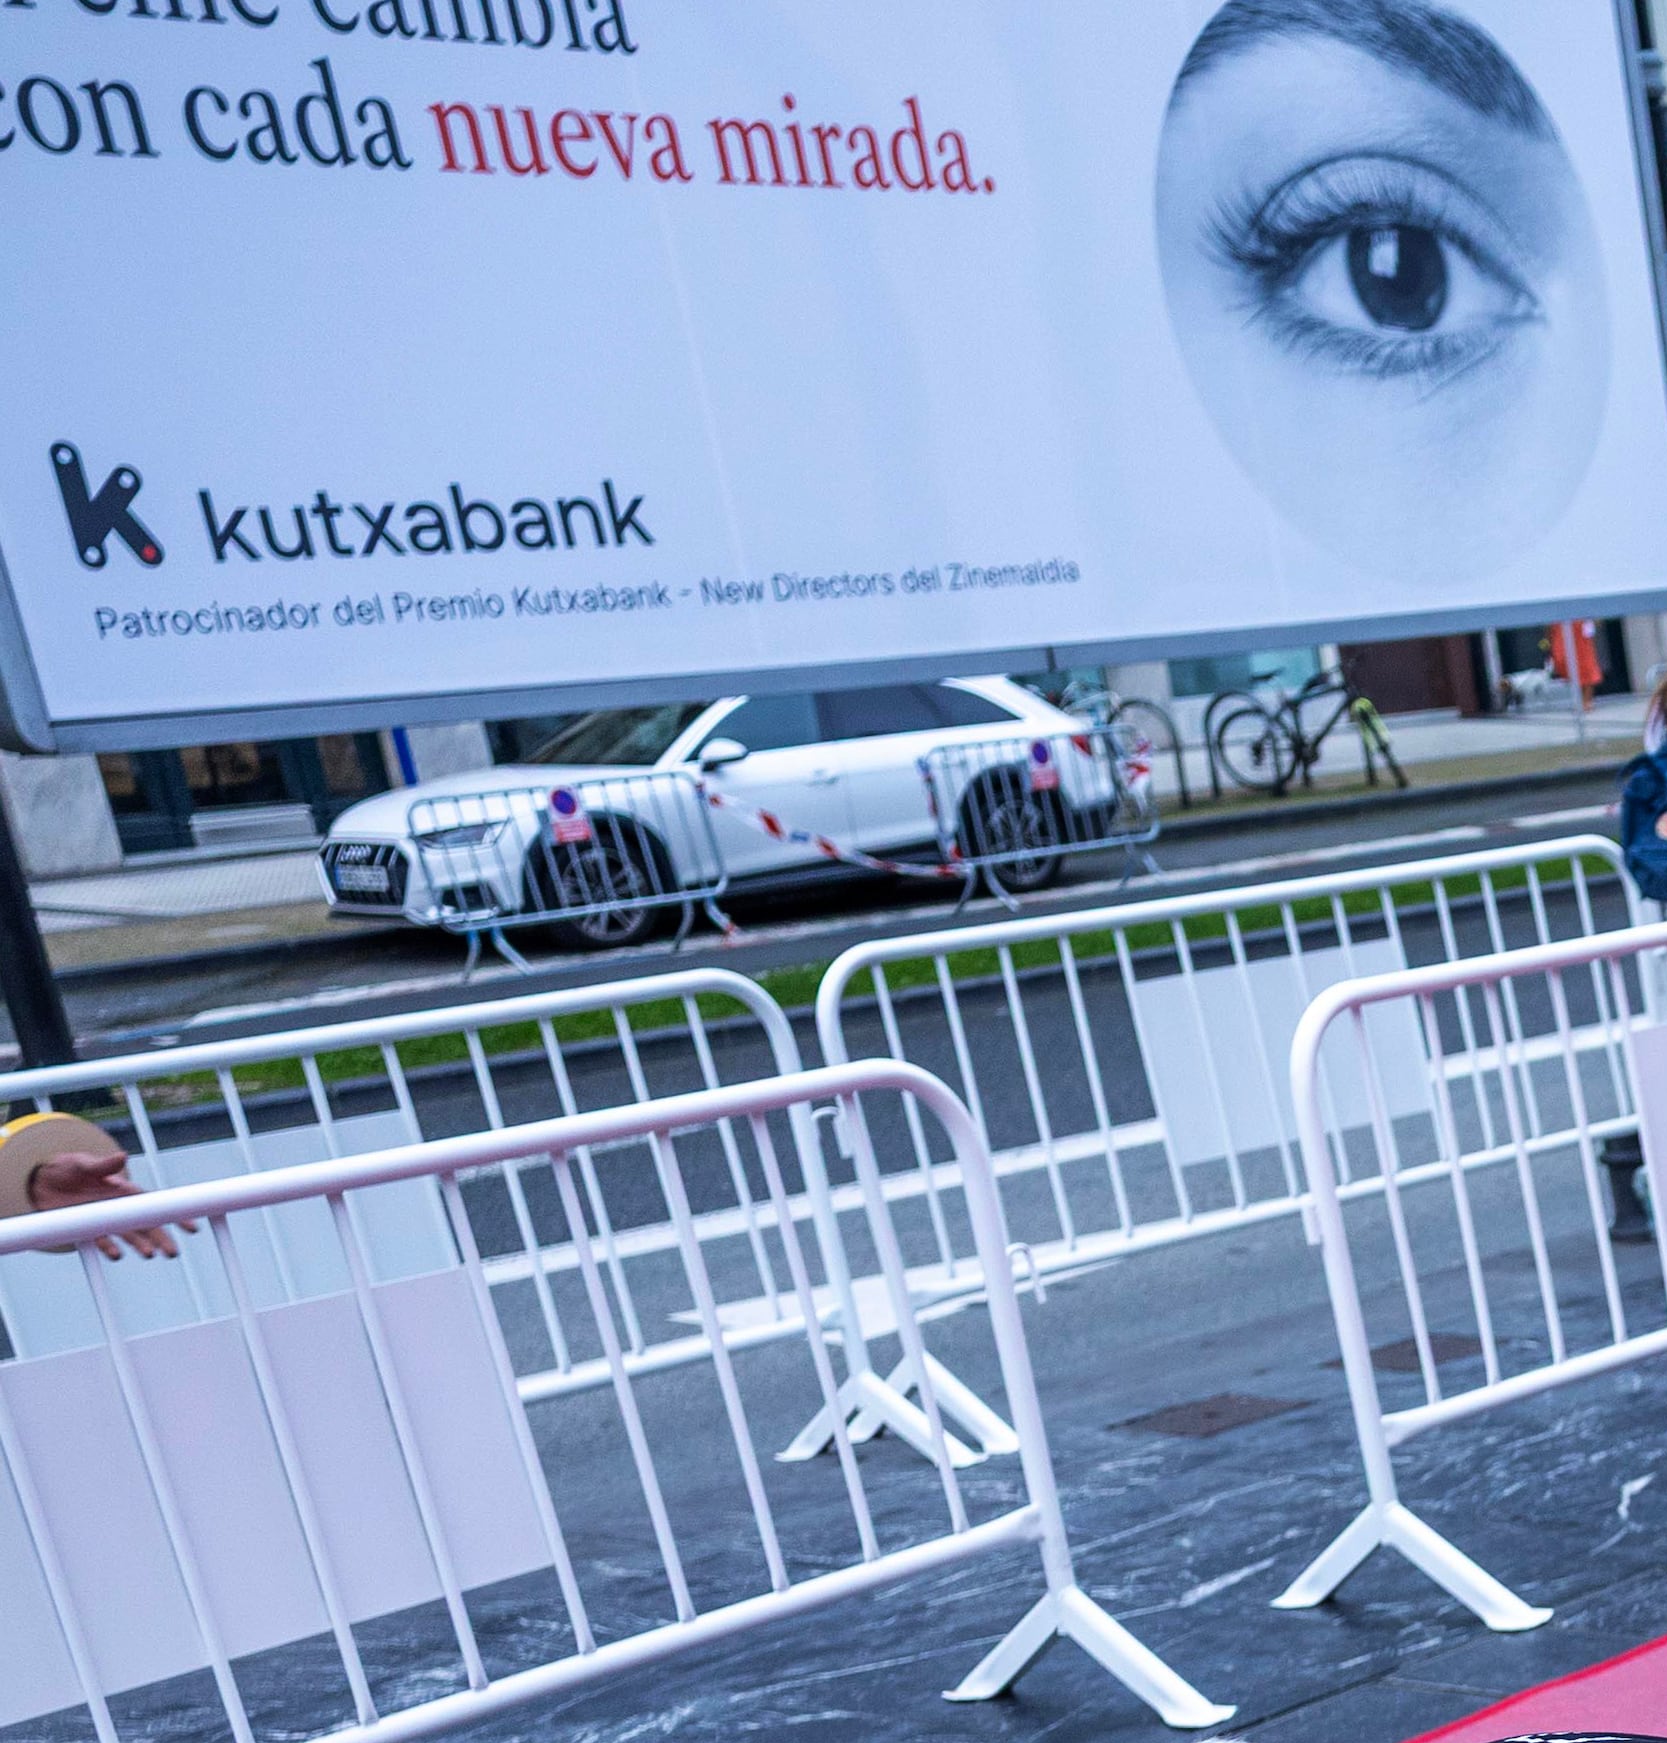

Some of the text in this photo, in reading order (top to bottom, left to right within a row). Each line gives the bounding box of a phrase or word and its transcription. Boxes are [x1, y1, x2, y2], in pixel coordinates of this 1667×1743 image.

[0, 55, 997, 194] on cada nueva mirada.
[196, 480, 657, 565] kutxabank
[94, 598, 321, 640] Patrocinador
[331, 592, 383, 629] del
[391, 585, 506, 624] Premio
[515, 578, 673, 614] Kutxabank
[700, 573, 766, 607] New
[771, 566, 897, 603] Directors
[900, 562, 943, 594] del
[946, 555, 1082, 592] Zinemaldia
